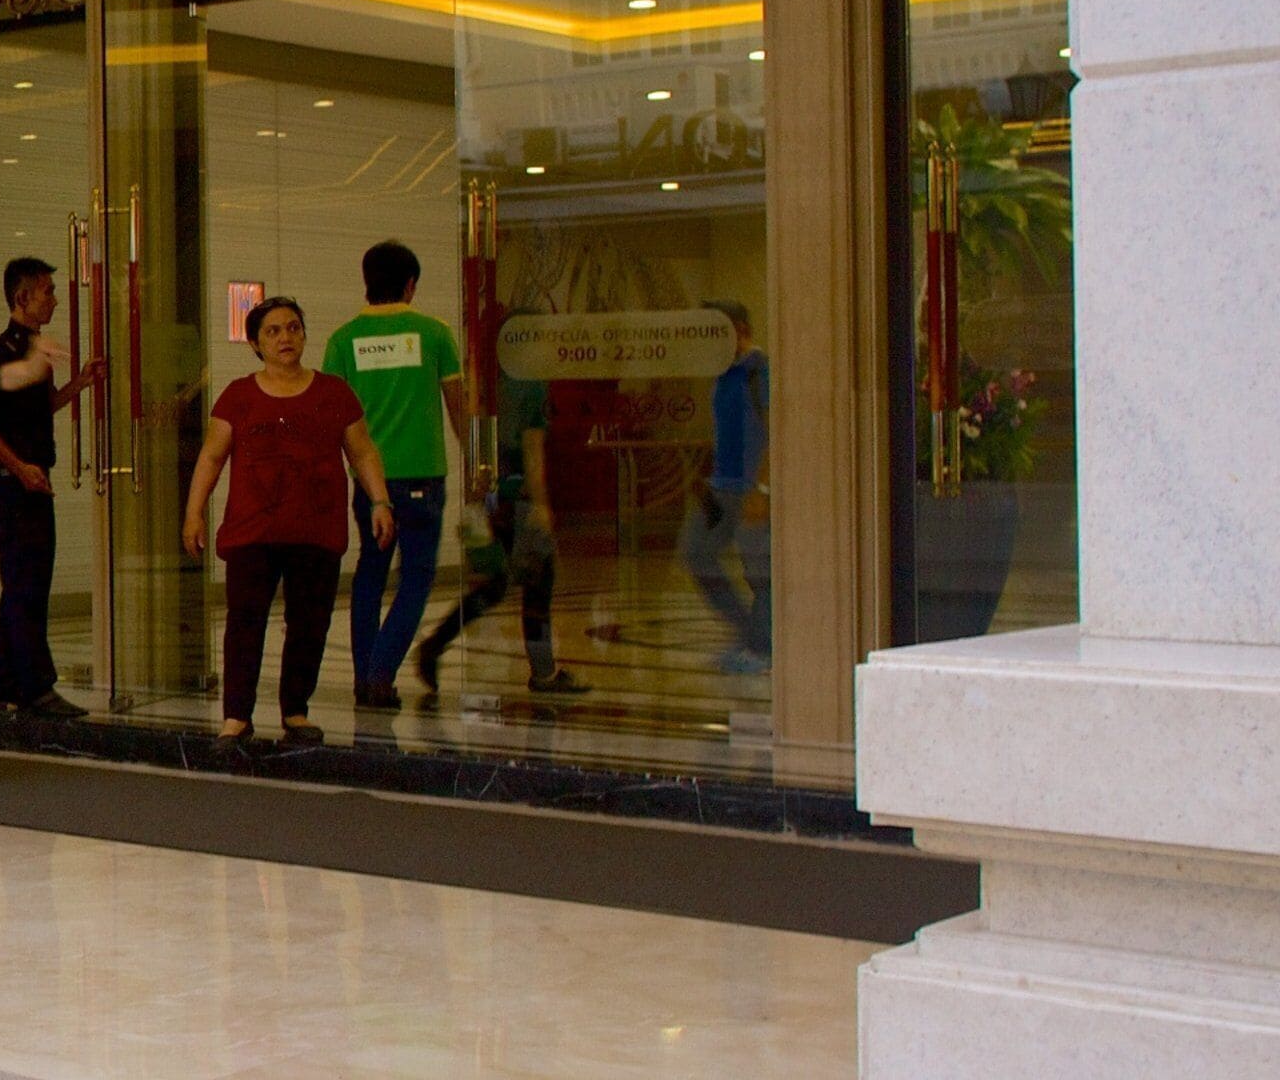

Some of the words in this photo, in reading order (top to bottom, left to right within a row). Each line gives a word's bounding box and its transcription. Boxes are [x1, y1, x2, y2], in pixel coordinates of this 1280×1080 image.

[602, 326, 670, 341] OPENING
[674, 324, 729, 340] HOURS
[358, 344, 396, 355] SONY
[558, 345, 597, 363] 9:00
[613, 343, 667, 361] 22:00
